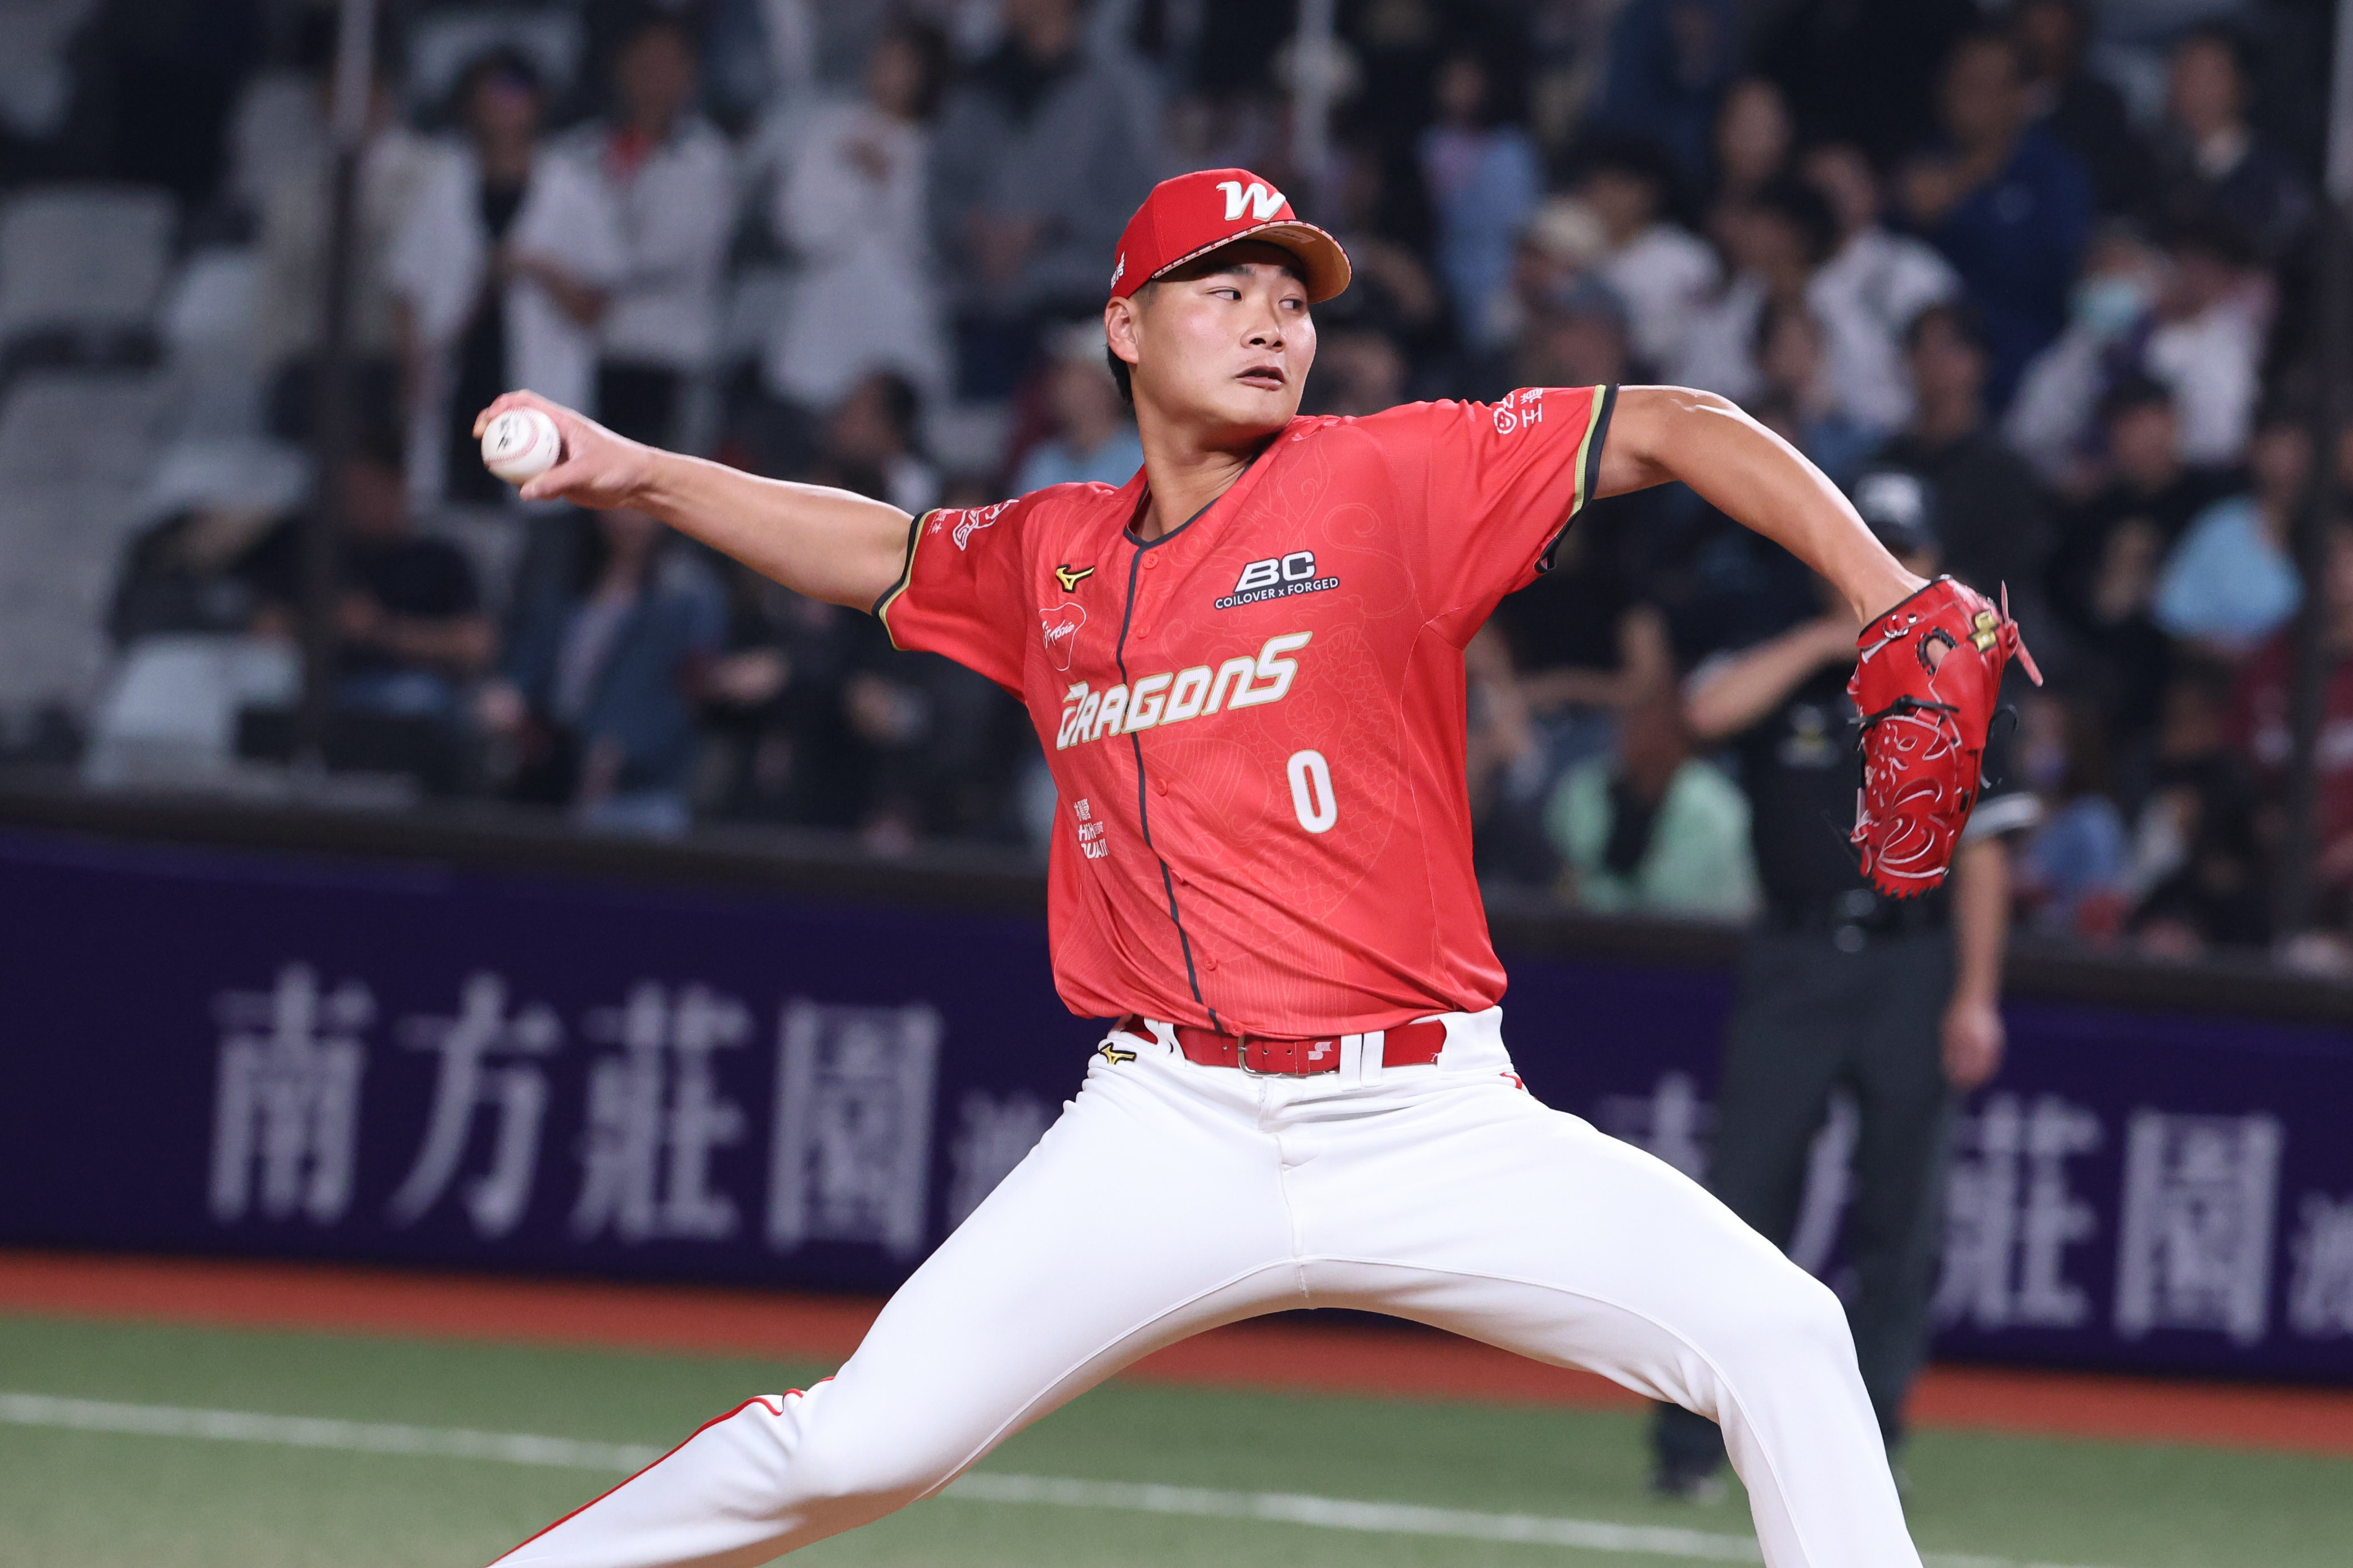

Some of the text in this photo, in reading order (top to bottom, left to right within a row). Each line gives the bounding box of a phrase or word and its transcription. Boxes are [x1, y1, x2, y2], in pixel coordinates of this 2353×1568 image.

[1216, 181, 1287, 222] W
[1215, 588, 1275, 609] COILOVER
[1287, 577, 1339, 595] FORGED
[1234, 551, 1315, 593] BC
[1056, 631, 1313, 751] DRAGONS
[1286, 749, 1338, 834] 0
